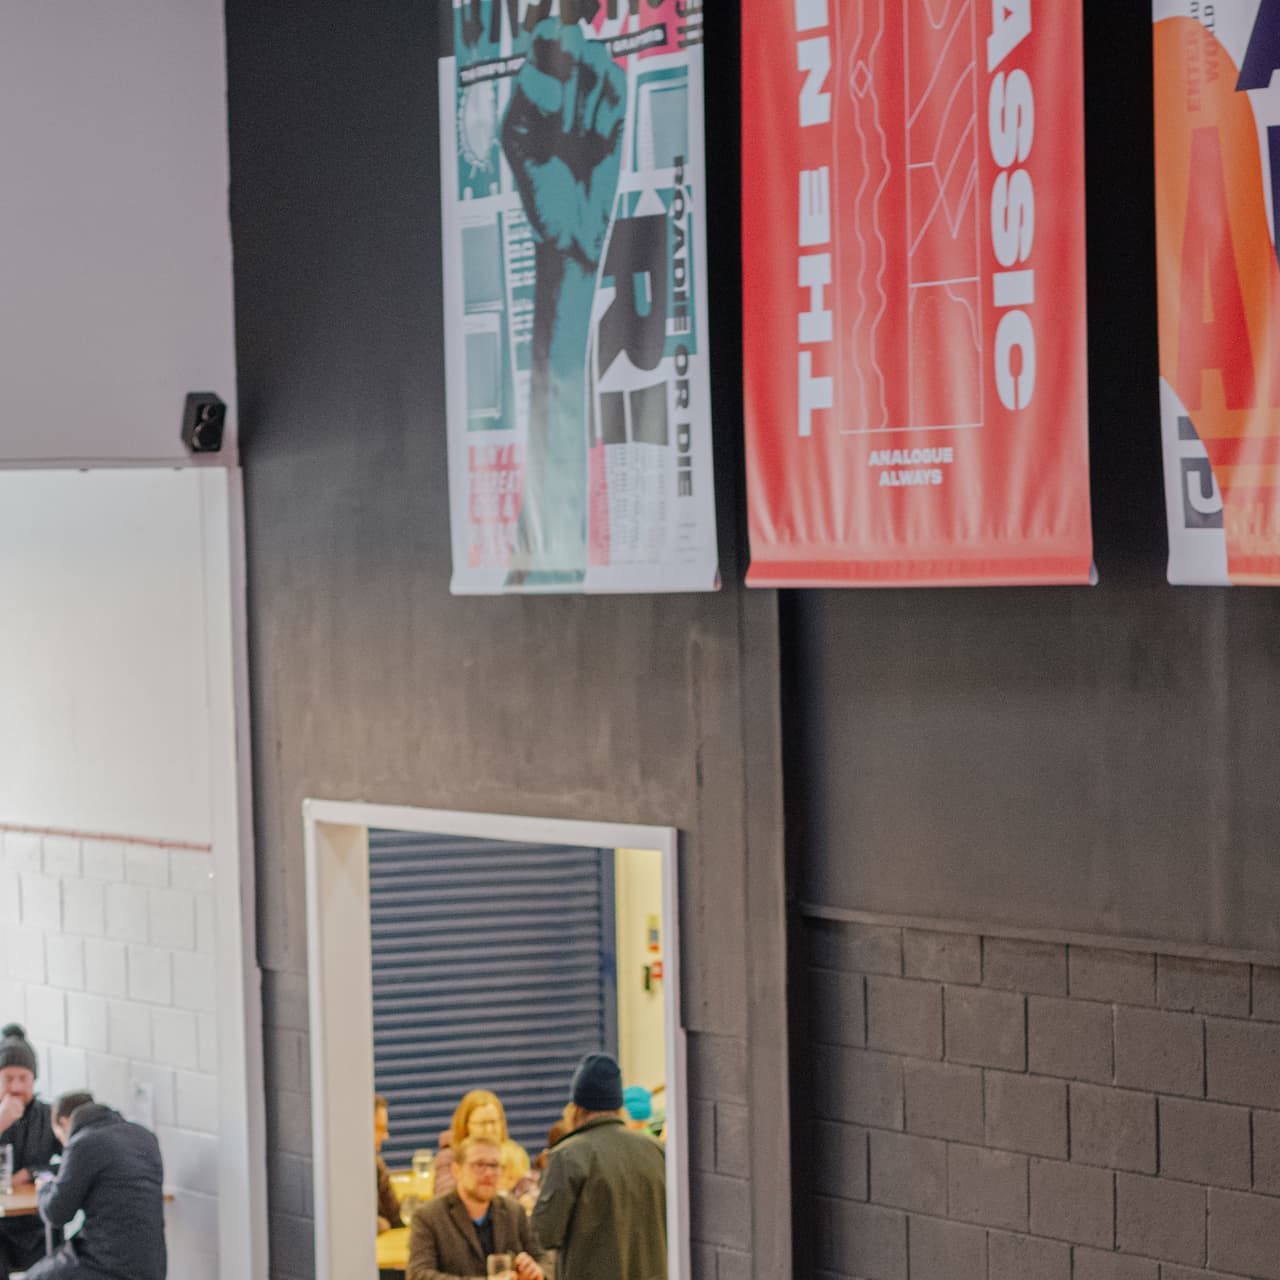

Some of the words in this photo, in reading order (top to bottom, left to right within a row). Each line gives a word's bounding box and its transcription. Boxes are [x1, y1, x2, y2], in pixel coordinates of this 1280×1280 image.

[673, 155, 691, 333] ROADIE
[798, 166, 834, 437] THE
[674, 350, 691, 411] OR
[676, 428, 693, 498] DIE
[868, 446, 954, 467] ANALOGUE
[879, 468, 943, 487] ALWAYS
